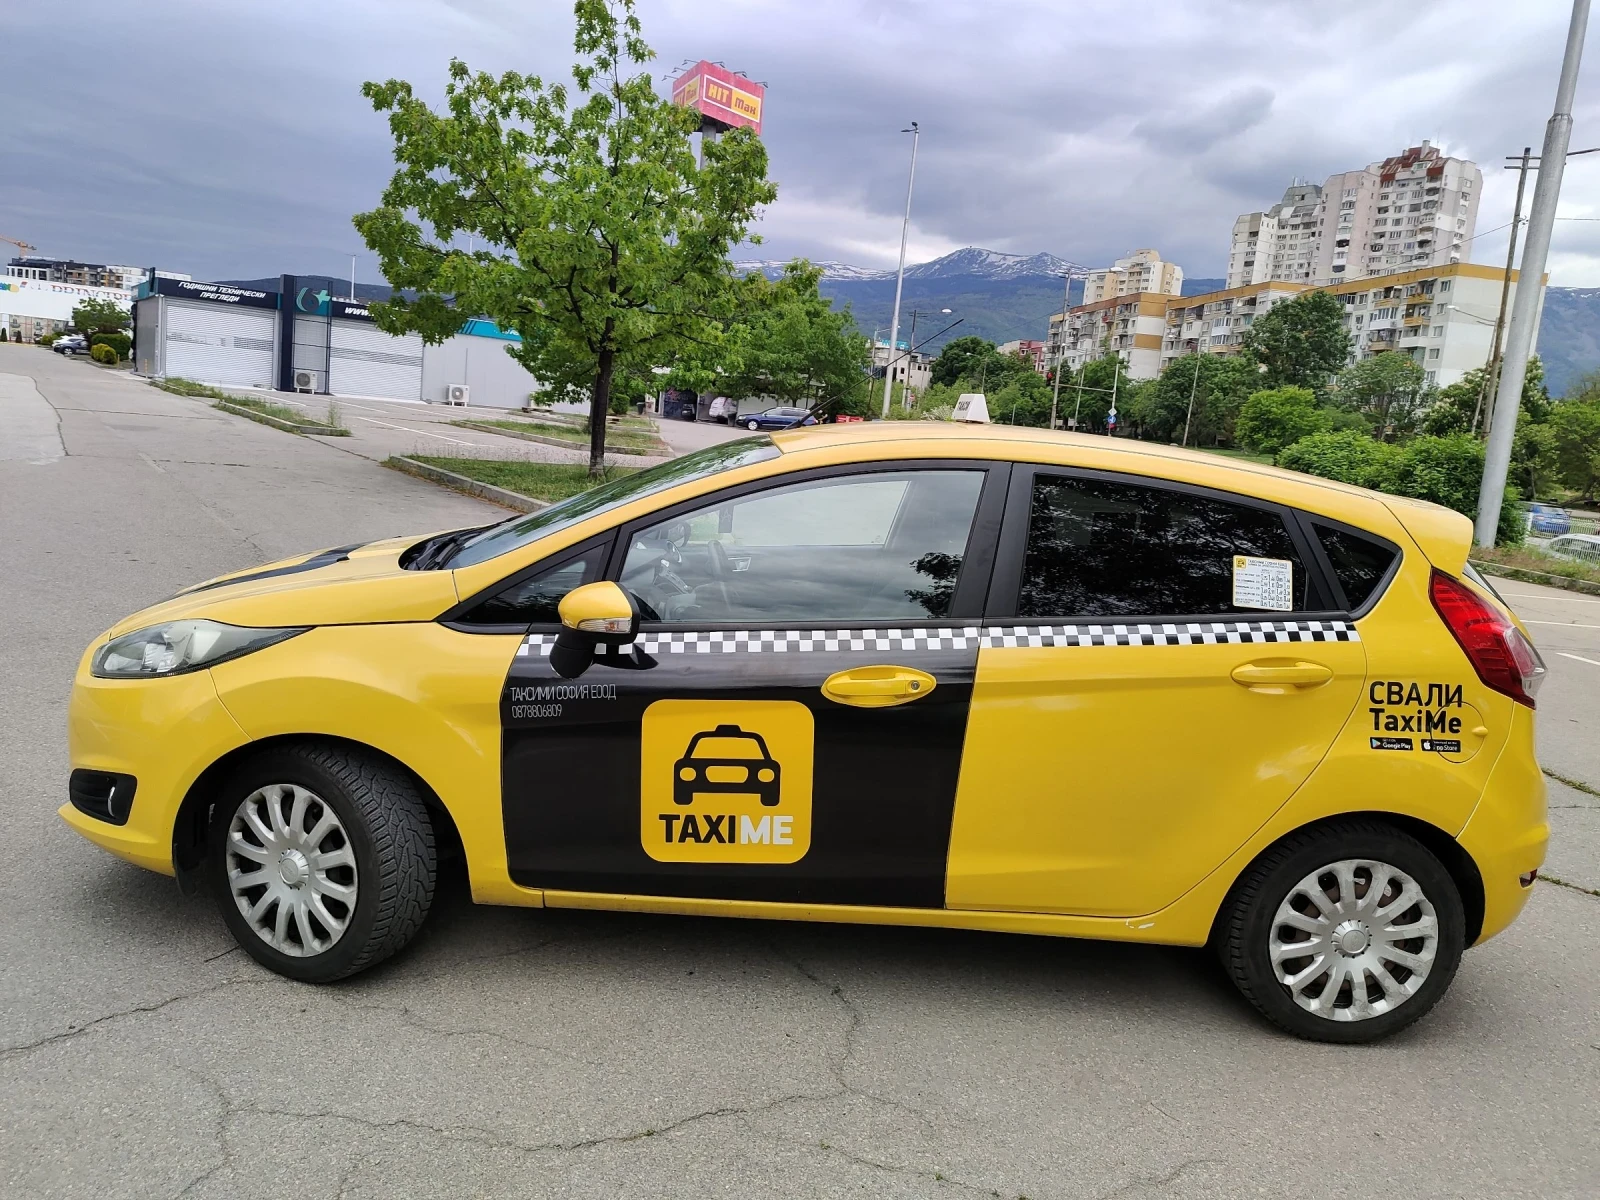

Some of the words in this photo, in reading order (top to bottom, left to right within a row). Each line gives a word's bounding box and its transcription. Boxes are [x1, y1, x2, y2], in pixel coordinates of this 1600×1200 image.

[708, 83, 729, 103] HIT
[178, 281, 217, 292] ГОДИШНИ
[218, 286, 266, 298] ТЕХНИЧЕСКИ
[200, 291, 240, 302] ПРЕГЛЕДИ
[510, 686, 554, 701] ТАКСИМИ
[556, 685, 589, 700] СОФИЯ
[591, 684, 616, 700] ЕООД
[1369, 681, 1462, 708] СВАЛИ
[512, 704, 562, 718] 0878806809
[1369, 708, 1461, 734] TaxiMe
[659, 814, 793, 845] TAXIME
